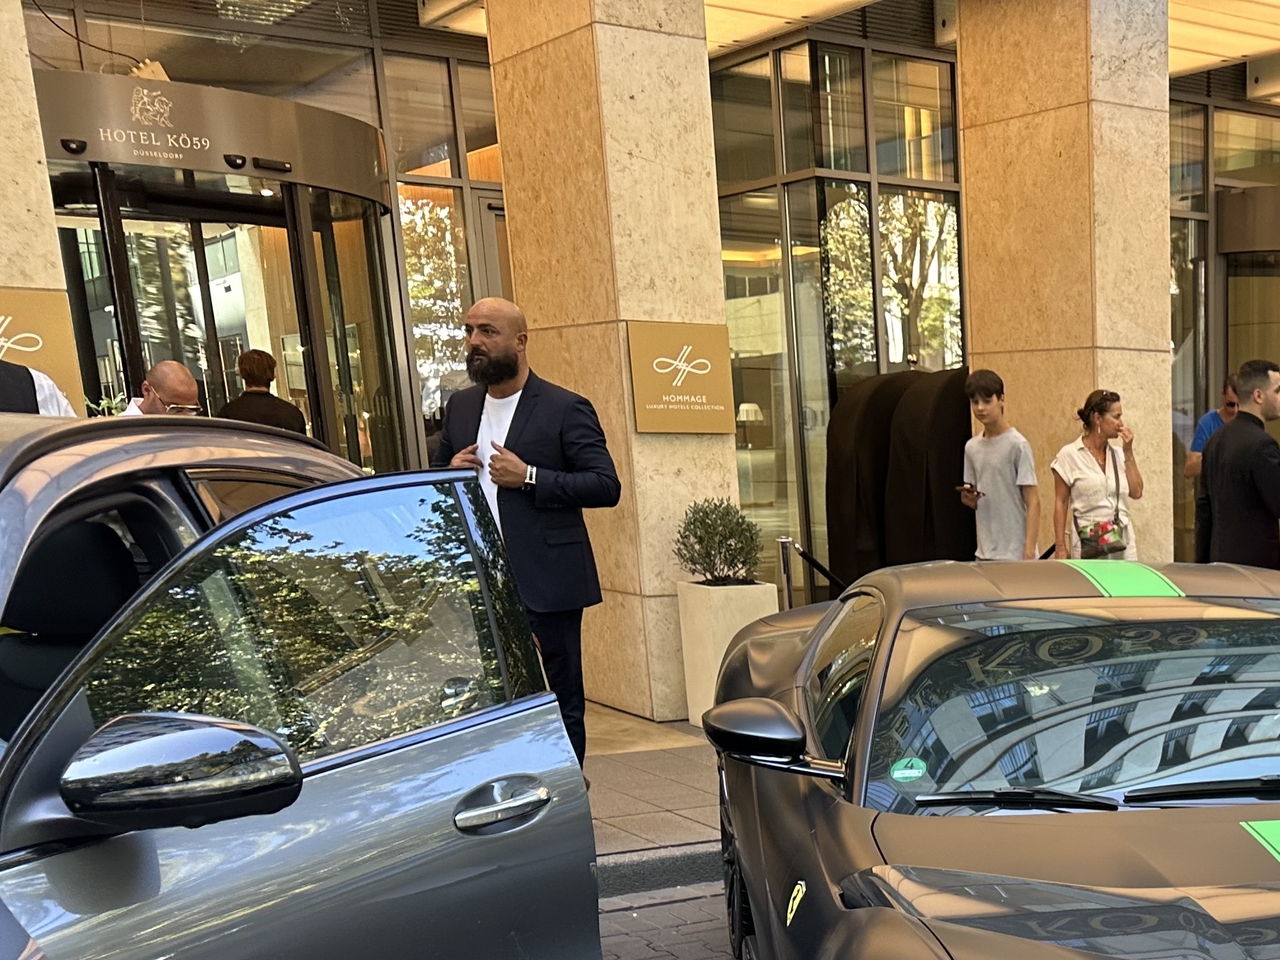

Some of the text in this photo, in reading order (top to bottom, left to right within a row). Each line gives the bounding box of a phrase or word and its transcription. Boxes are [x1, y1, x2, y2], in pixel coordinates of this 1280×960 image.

[98, 128, 210, 150] HOTEL KÖ59
[133, 149, 184, 160] DÜSSELDORF
[662, 394, 707, 403] HOMMAGE
[903, 757, 915, 770] 4
